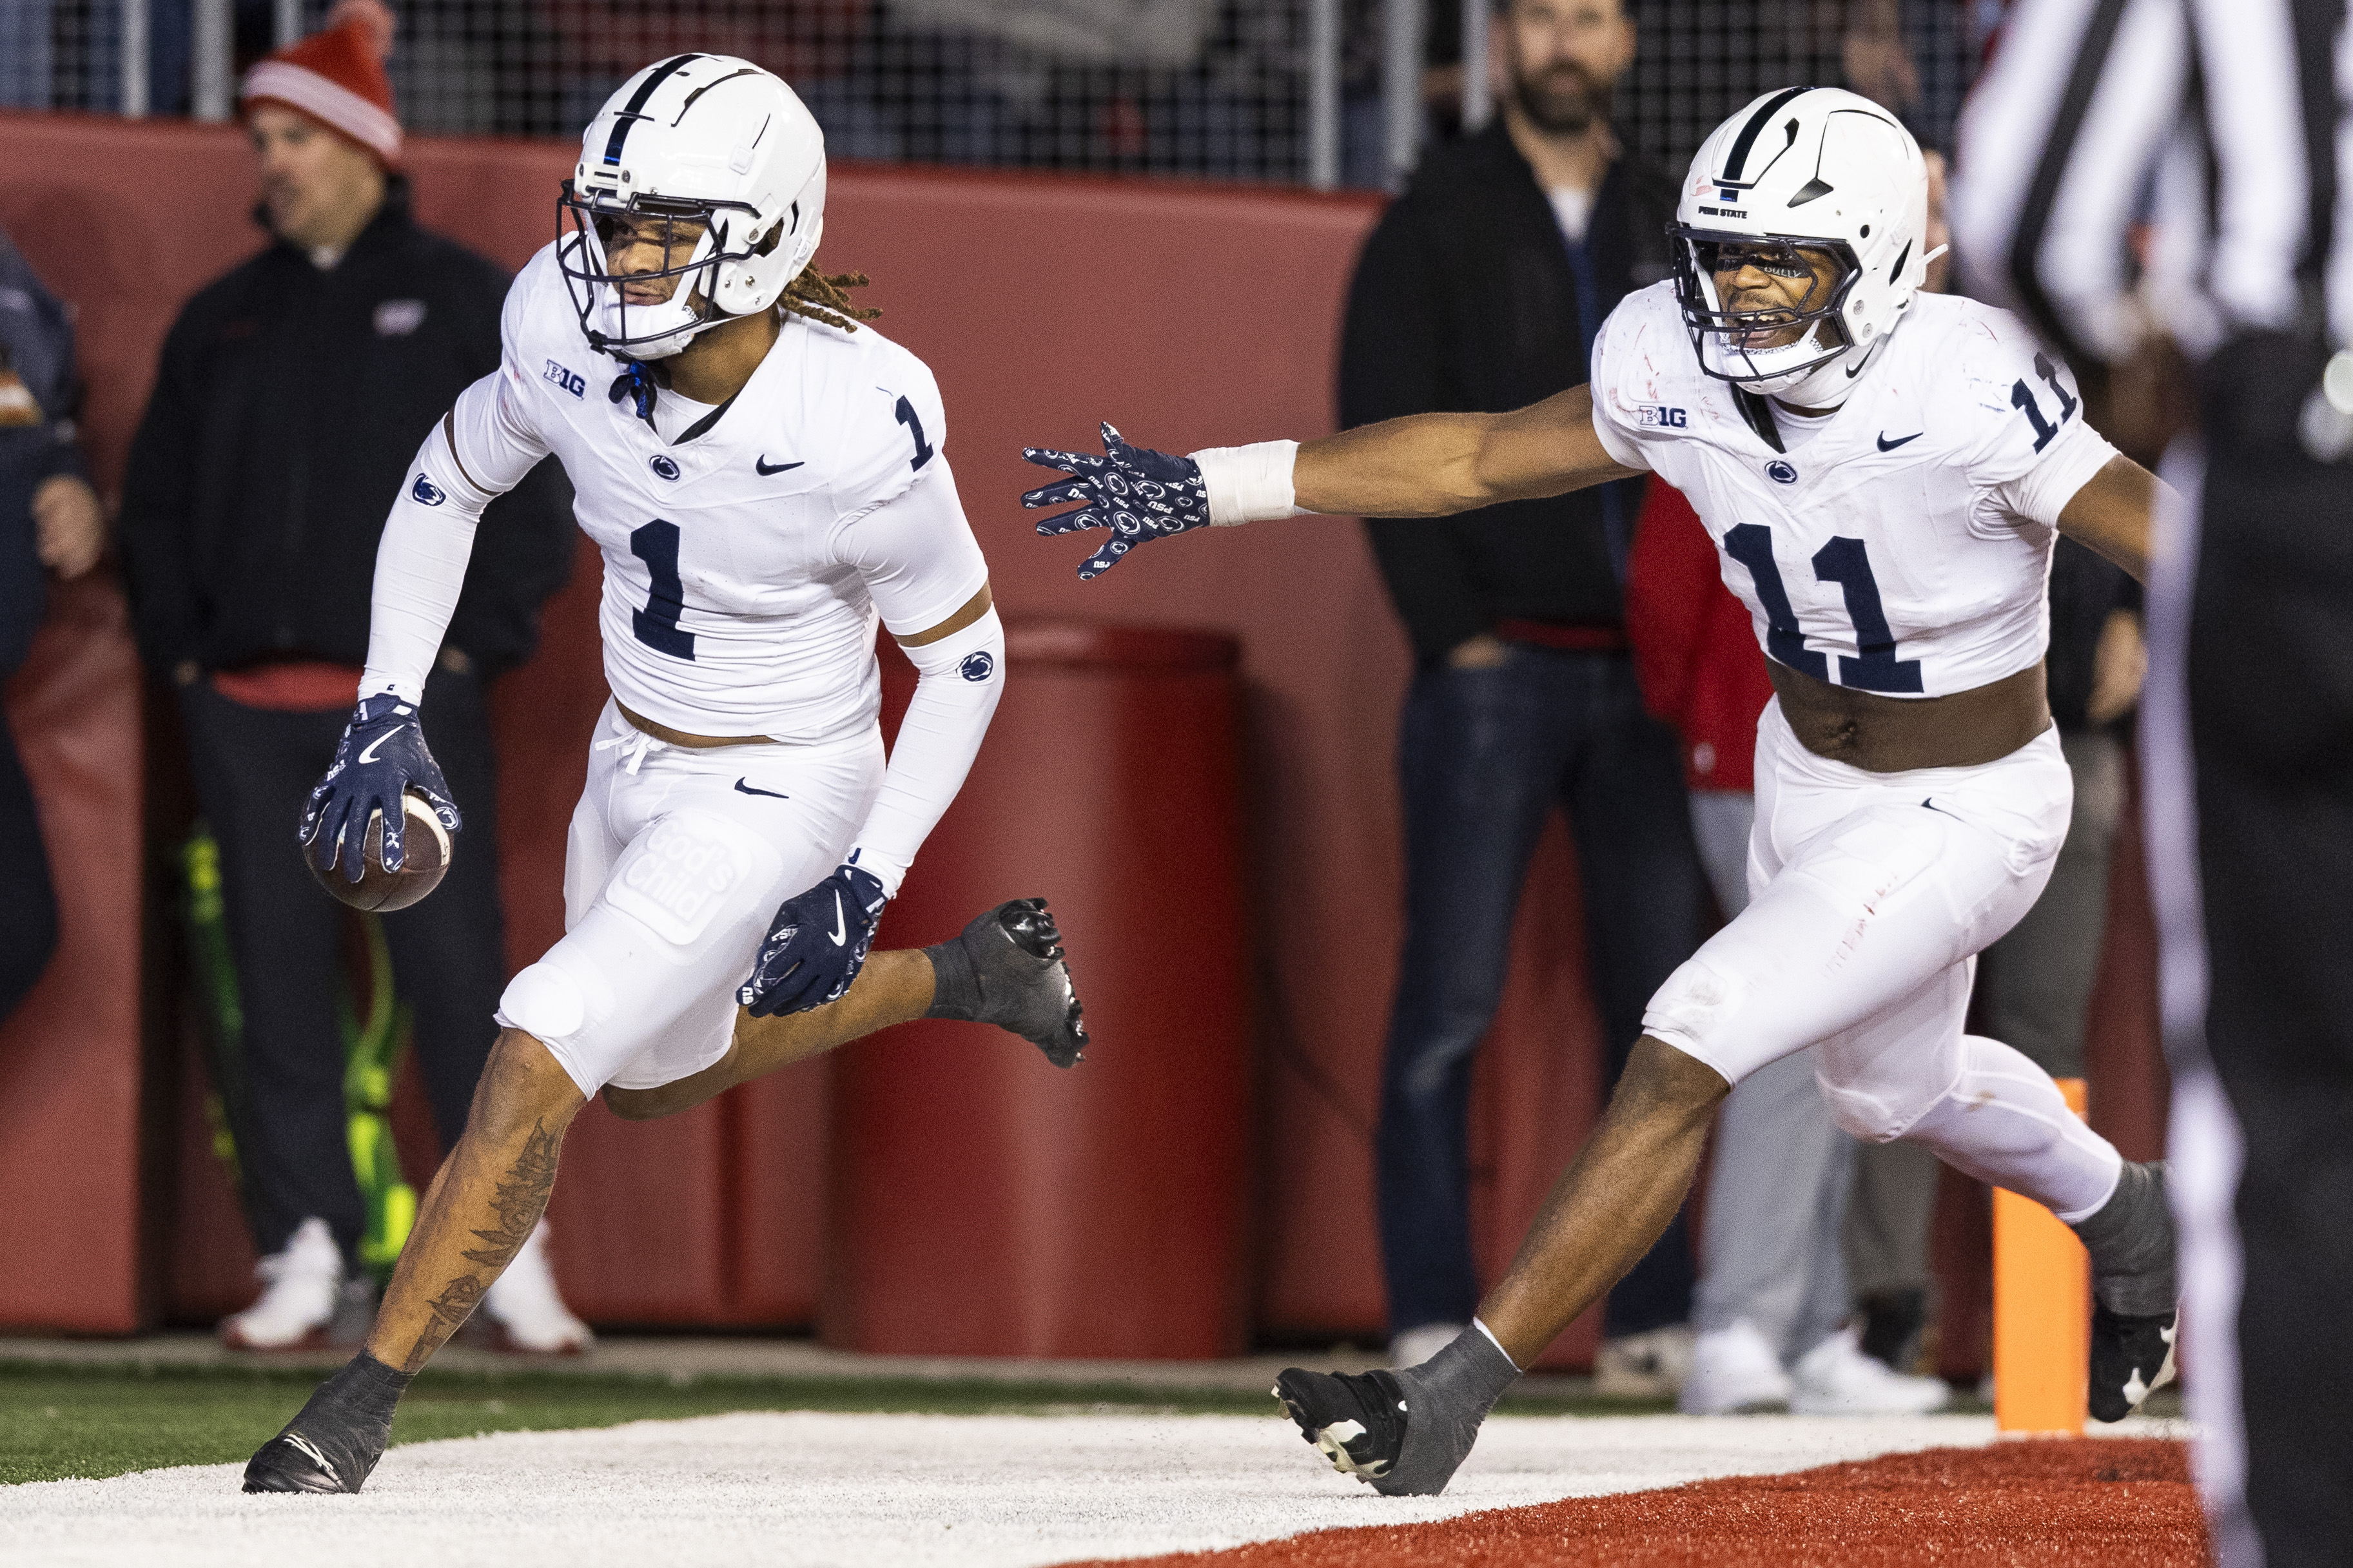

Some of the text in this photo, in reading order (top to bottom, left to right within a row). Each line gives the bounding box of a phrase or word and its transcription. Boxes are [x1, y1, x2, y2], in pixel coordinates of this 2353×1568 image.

[1719, 208, 1748, 219] STATE
[895, 394, 933, 472] 1
[2011, 352, 2077, 455] 11
[1088, 476, 1103, 489] PSU
[1113, 497, 1129, 508] PSU
[1147, 501, 1173, 514] PSU
[1142, 516, 1158, 529] PSU
[630, 518, 696, 662] 1
[1724, 522, 1924, 693] 11
[625, 853, 710, 922] Child
[647, 819, 734, 891] God's
